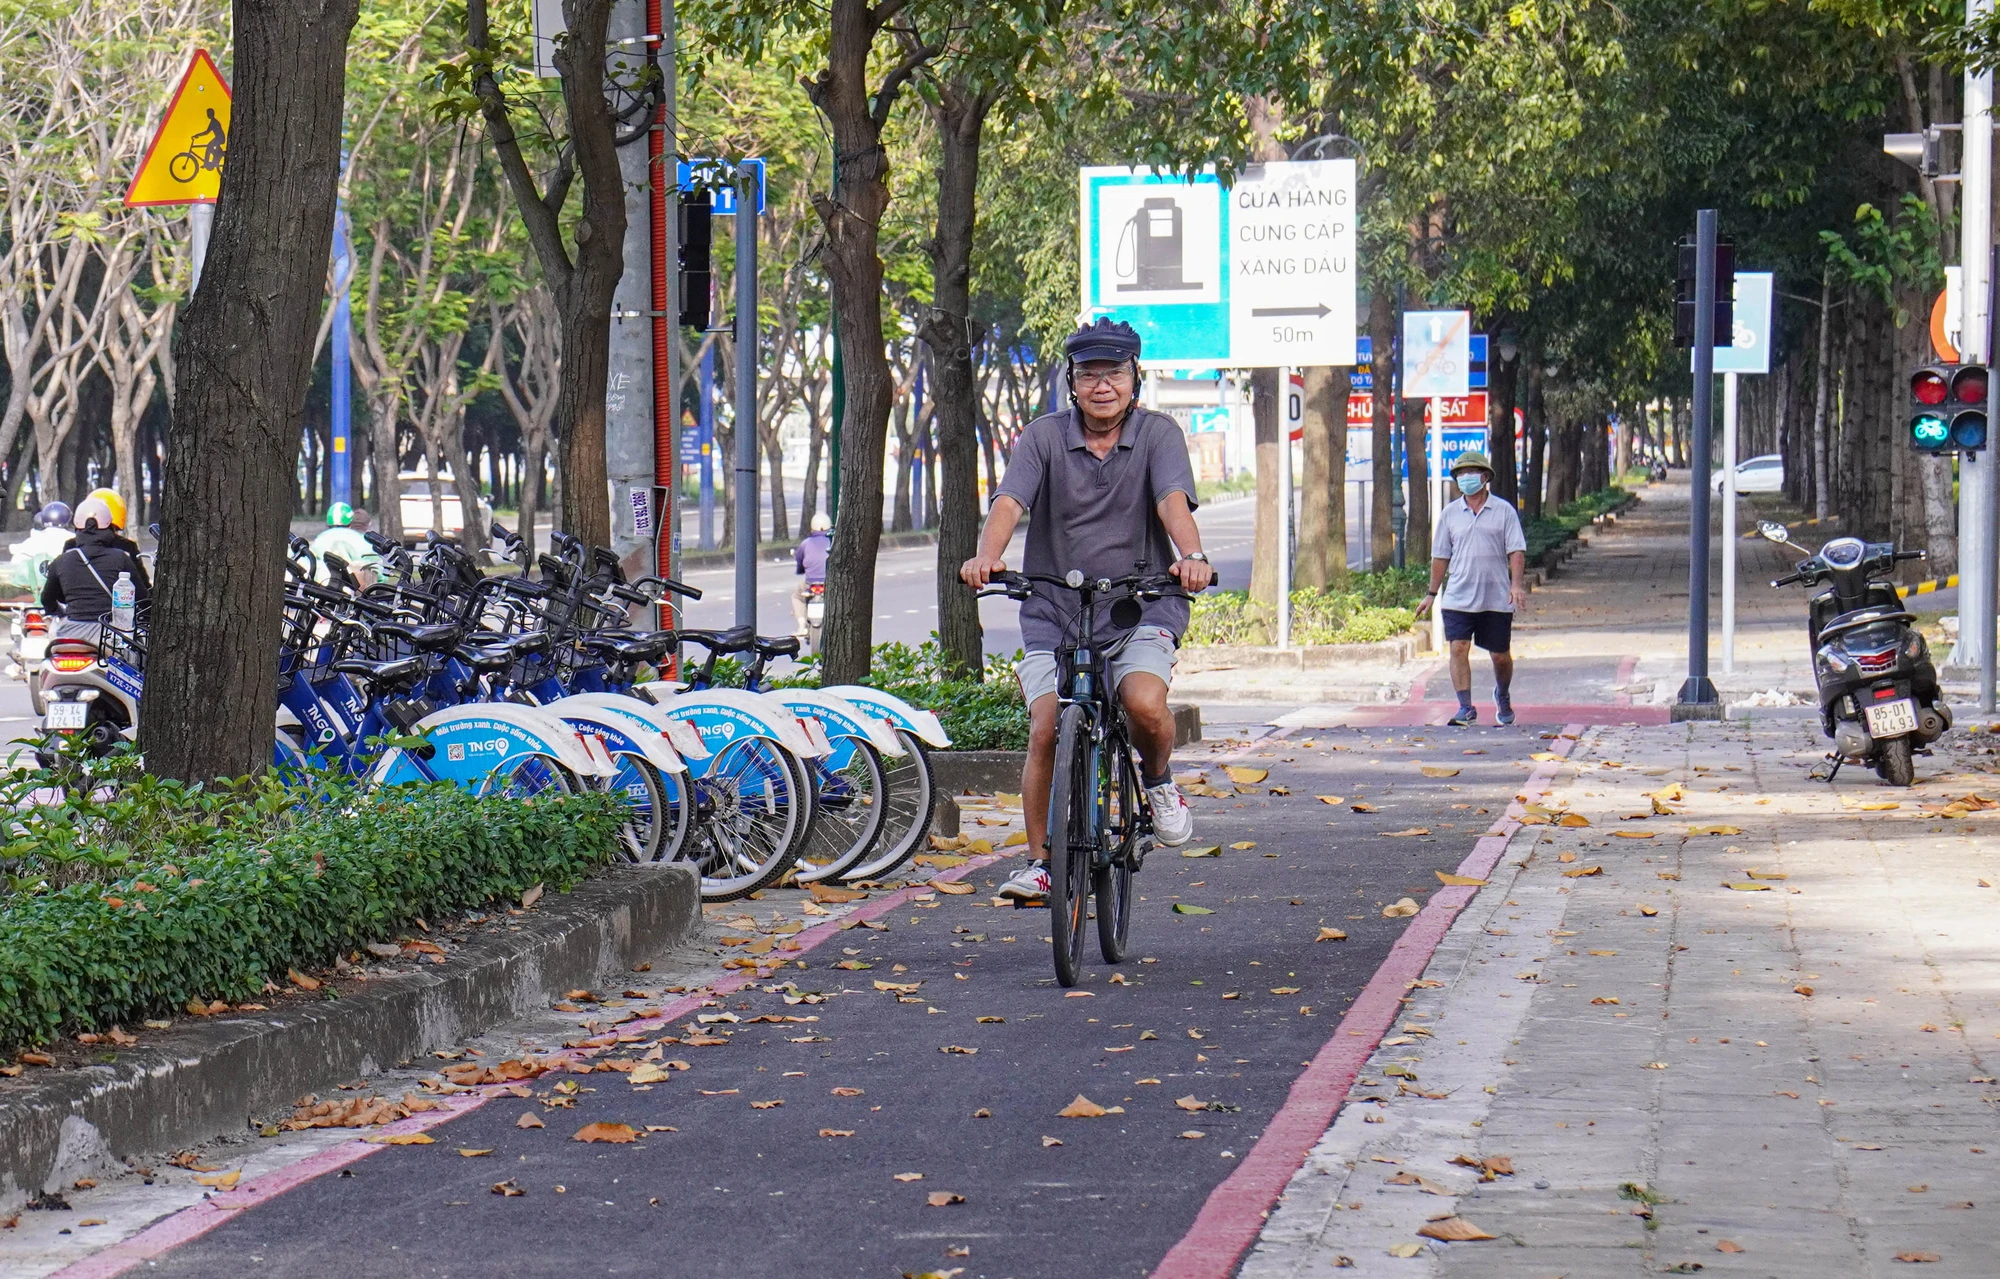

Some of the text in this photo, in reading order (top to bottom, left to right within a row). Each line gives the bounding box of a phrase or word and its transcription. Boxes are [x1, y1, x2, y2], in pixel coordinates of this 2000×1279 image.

[1239, 184, 1347, 209] CỬA HÀNG
[1240, 224, 1297, 242] CUNG
[1273, 326, 1313, 342] 50m
[609, 371, 631, 391] XE
[1289, 394, 1301, 421] 0
[1873, 702, 1906, 720] 85-D1
